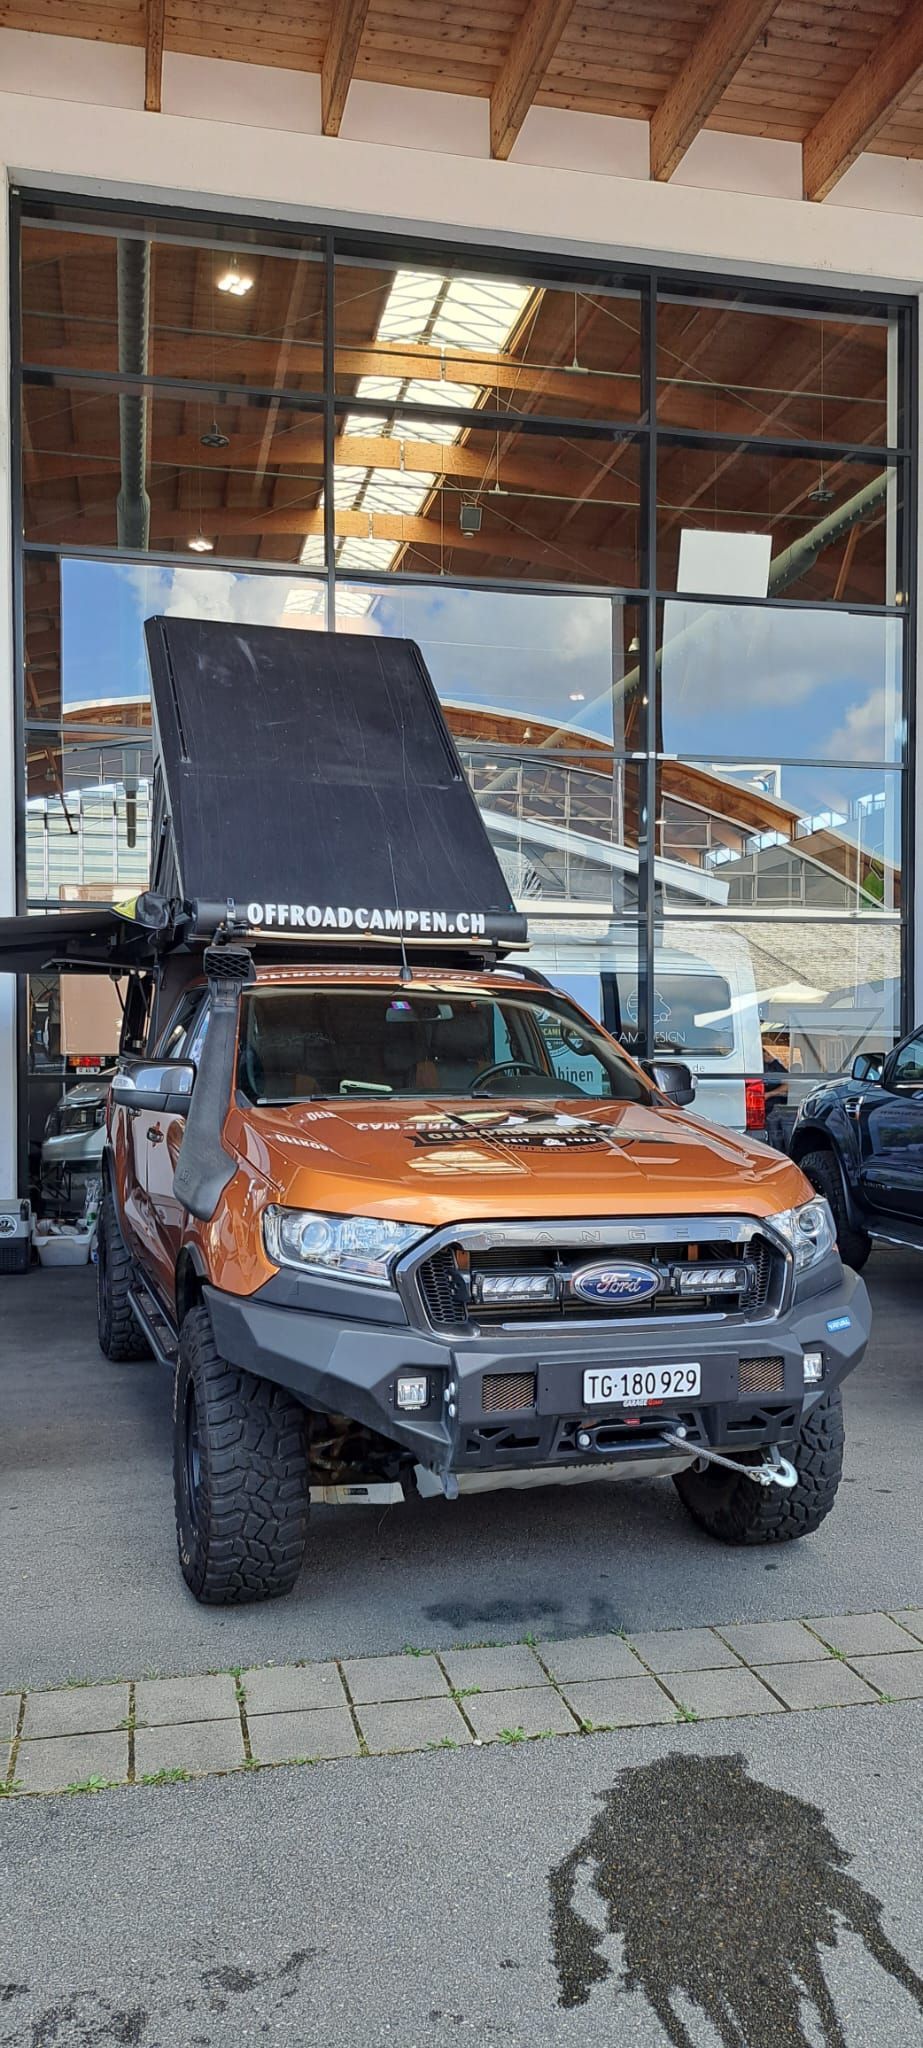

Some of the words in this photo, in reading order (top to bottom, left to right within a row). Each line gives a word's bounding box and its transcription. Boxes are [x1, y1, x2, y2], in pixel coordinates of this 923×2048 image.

[247, 902, 485, 934] OFFROADCAMPEN.CH
[486, 1225, 733, 1244] RANGER
[596, 1271, 641, 1294] Ford
[660, 1369, 697, 1394] 929
